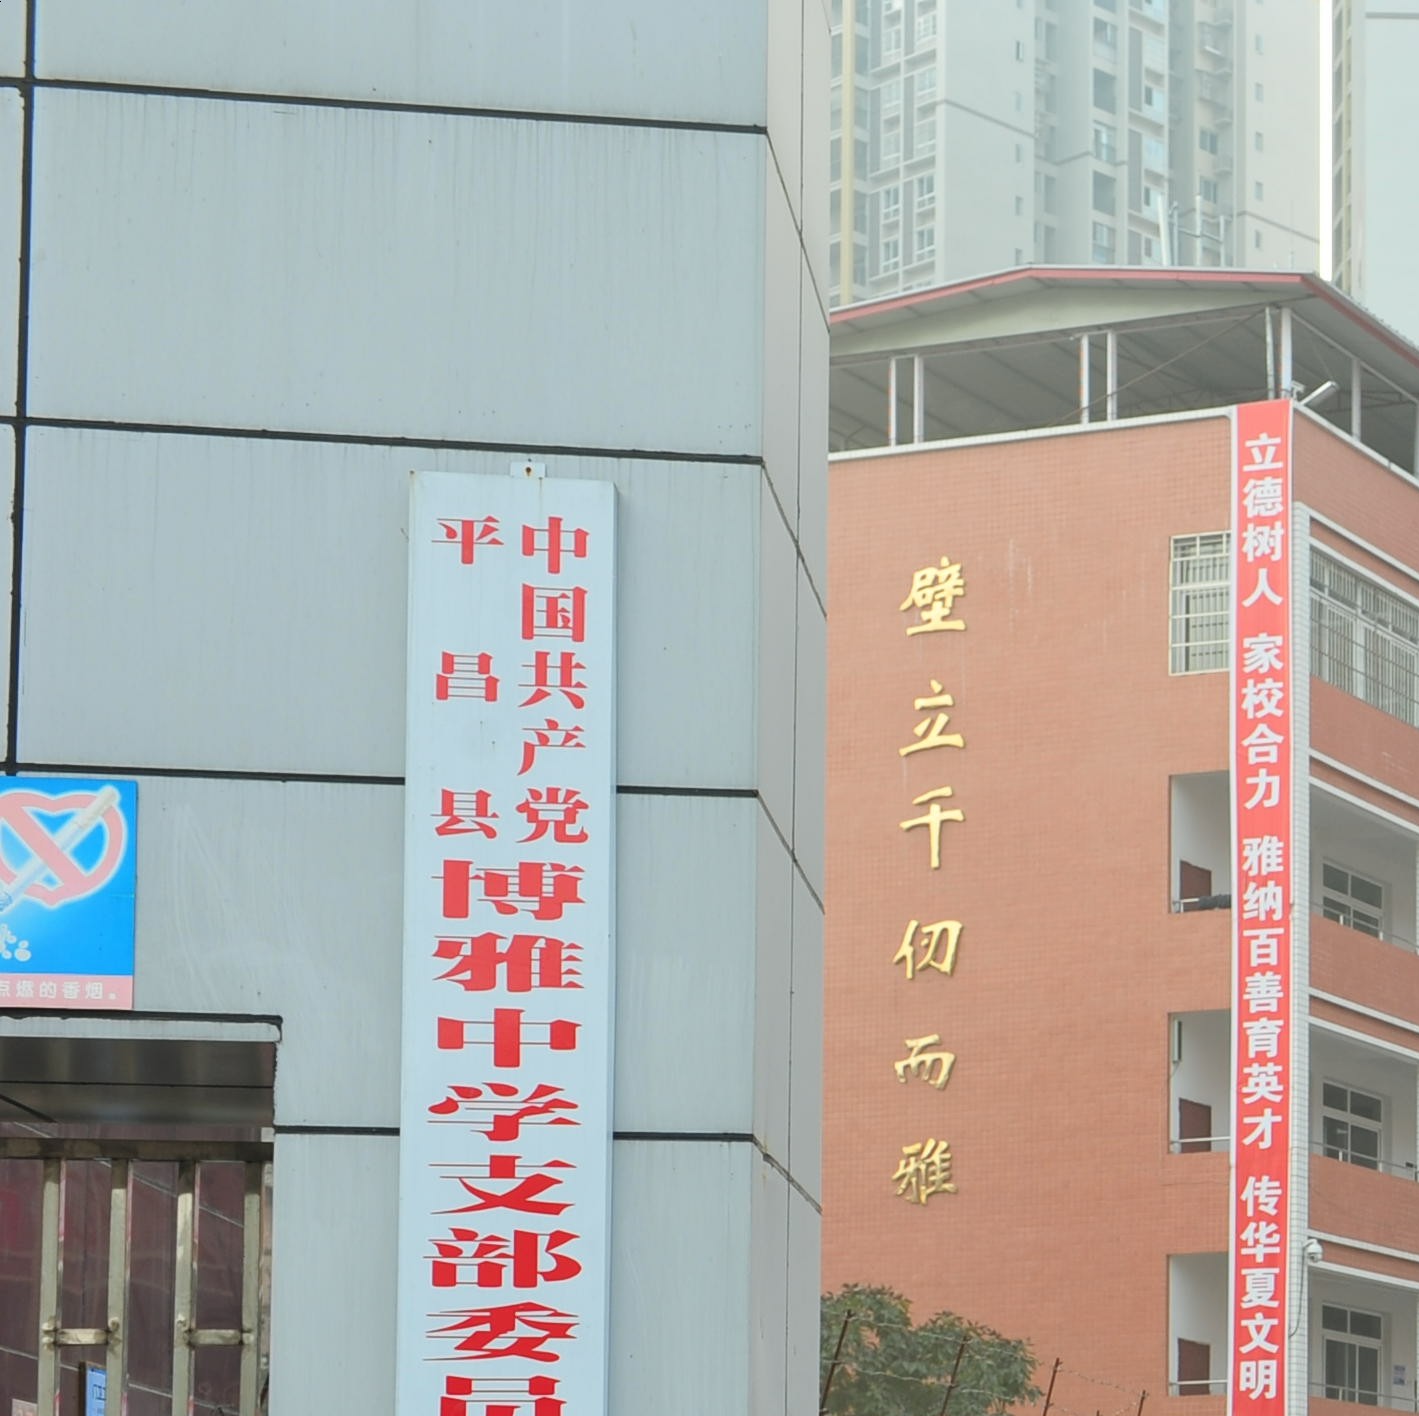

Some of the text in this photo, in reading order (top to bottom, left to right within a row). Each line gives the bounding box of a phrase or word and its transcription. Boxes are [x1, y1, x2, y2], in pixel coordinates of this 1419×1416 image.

[431, 515, 503, 839] 平昌县
[516, 516, 590, 845] 中国共产党
[892, 556, 966, 1204] 壁立千仞而雅
[1239, 433, 1284, 1400] 立德树人 家校合力 雅纳百善育英才 传华夏文明
